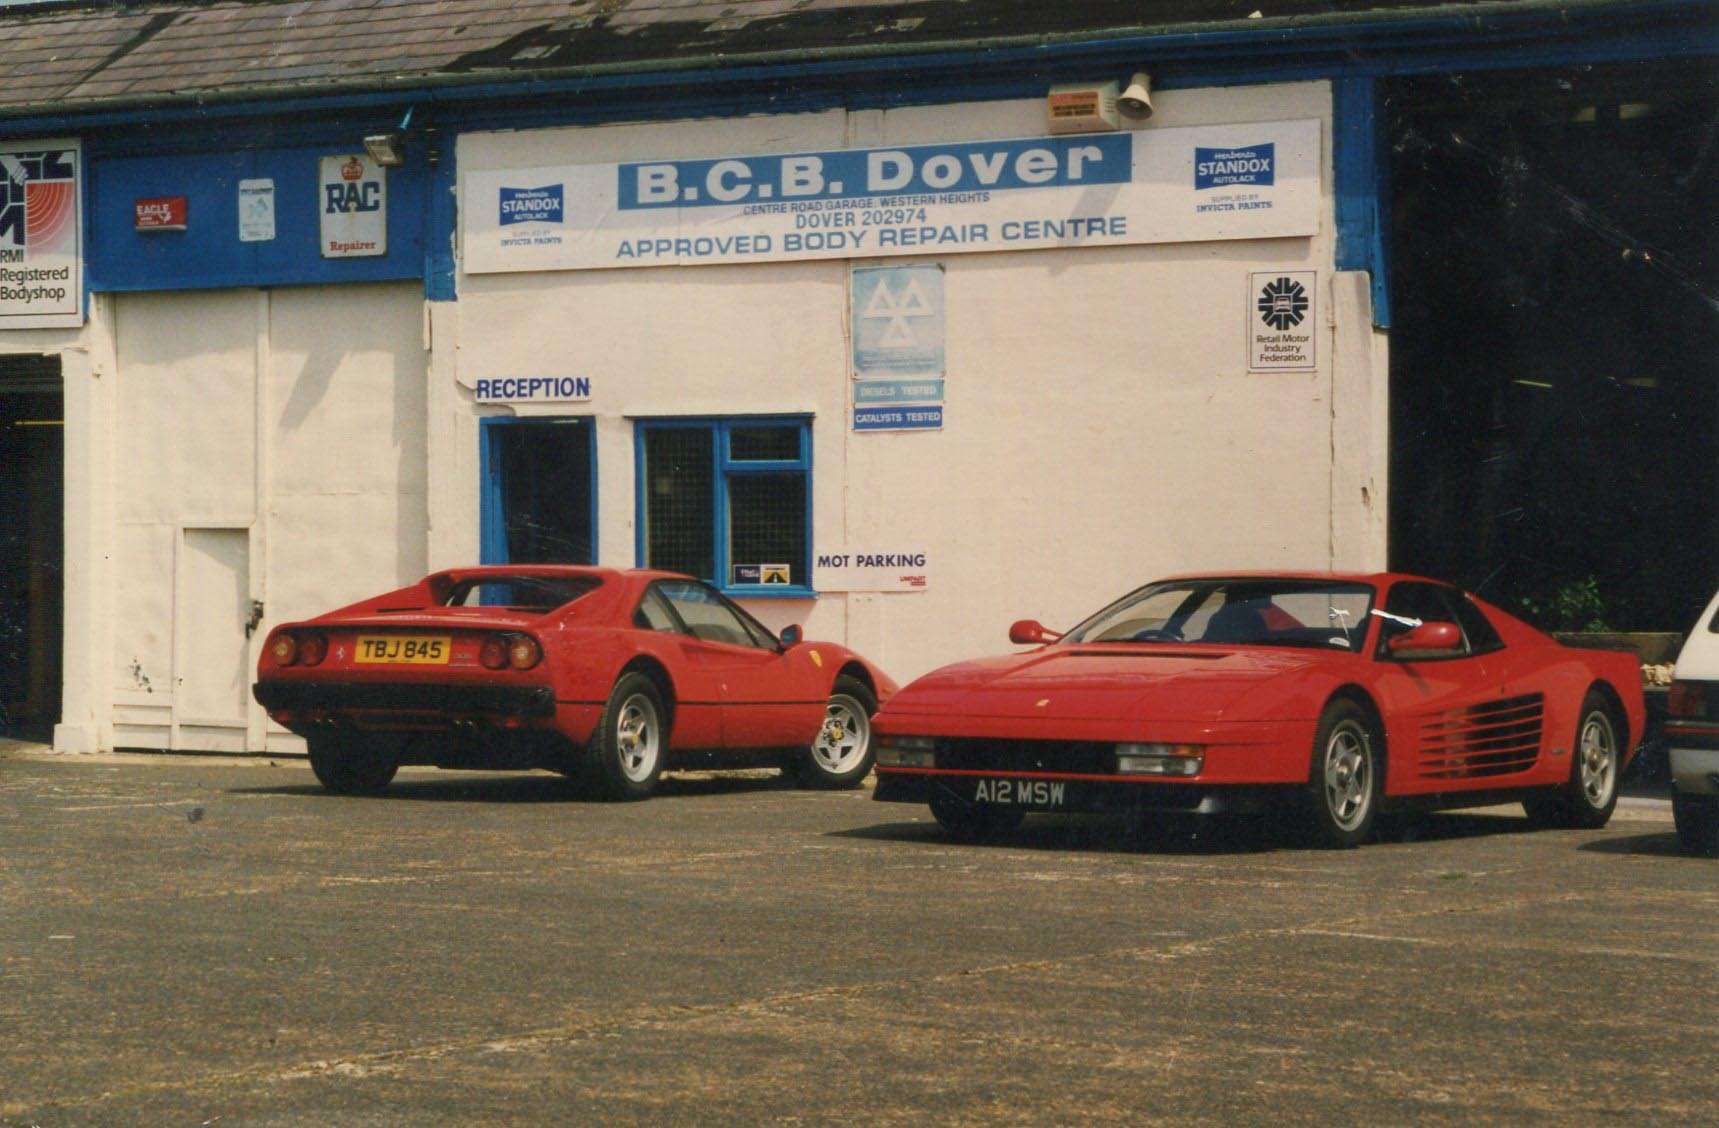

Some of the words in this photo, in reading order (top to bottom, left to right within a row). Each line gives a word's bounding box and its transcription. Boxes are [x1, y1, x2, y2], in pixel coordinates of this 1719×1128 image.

[637, 156, 843, 203] B.C.B.
[867, 145, 1102, 192] Dover
[1198, 159, 1271, 176] STANDOX
[326, 181, 380, 214] RAC
[502, 198, 560, 213] STANDOX
[743, 203, 787, 215] CENTRE
[791, 201, 823, 213] ROAD
[880, 195, 937, 208] WESTERN
[939, 192, 991, 205] HEIGHTS
[1196, 203, 1234, 212] INVICTA
[1238, 201, 1272, 210] PAINTS
[796, 212, 856, 229] DOVER
[862, 208, 927, 226] 202974
[534, 236, 562, 245] PAINTS
[616, 234, 772, 258] APPROVED
[784, 229, 867, 251] BODY
[879, 223, 989, 247] REPAIR
[1001, 216, 1127, 241] CENTRE
[330, 240, 376, 252] Repairer
[0, 249, 24, 264] RMI
[0, 266, 69, 286] Registered
[0, 287, 65, 304] Bodyshop
[1256, 334, 1281, 343] Retail
[1282, 334, 1310, 343] Motor
[1264, 343, 1301, 353] Industry
[1259, 353, 1306, 362] Federation
[477, 377, 590, 398] RECEPTION
[855, 412, 903, 424] CATALYSTS
[905, 411, 941, 422] TESTED
[818, 555, 850, 568] MOT
[856, 554, 926, 568] PARKING
[363, 639, 401, 658] TBJ
[404, 639, 443, 659] 845
[975, 781, 1013, 802] A12
[1017, 783, 1065, 805] MSW
